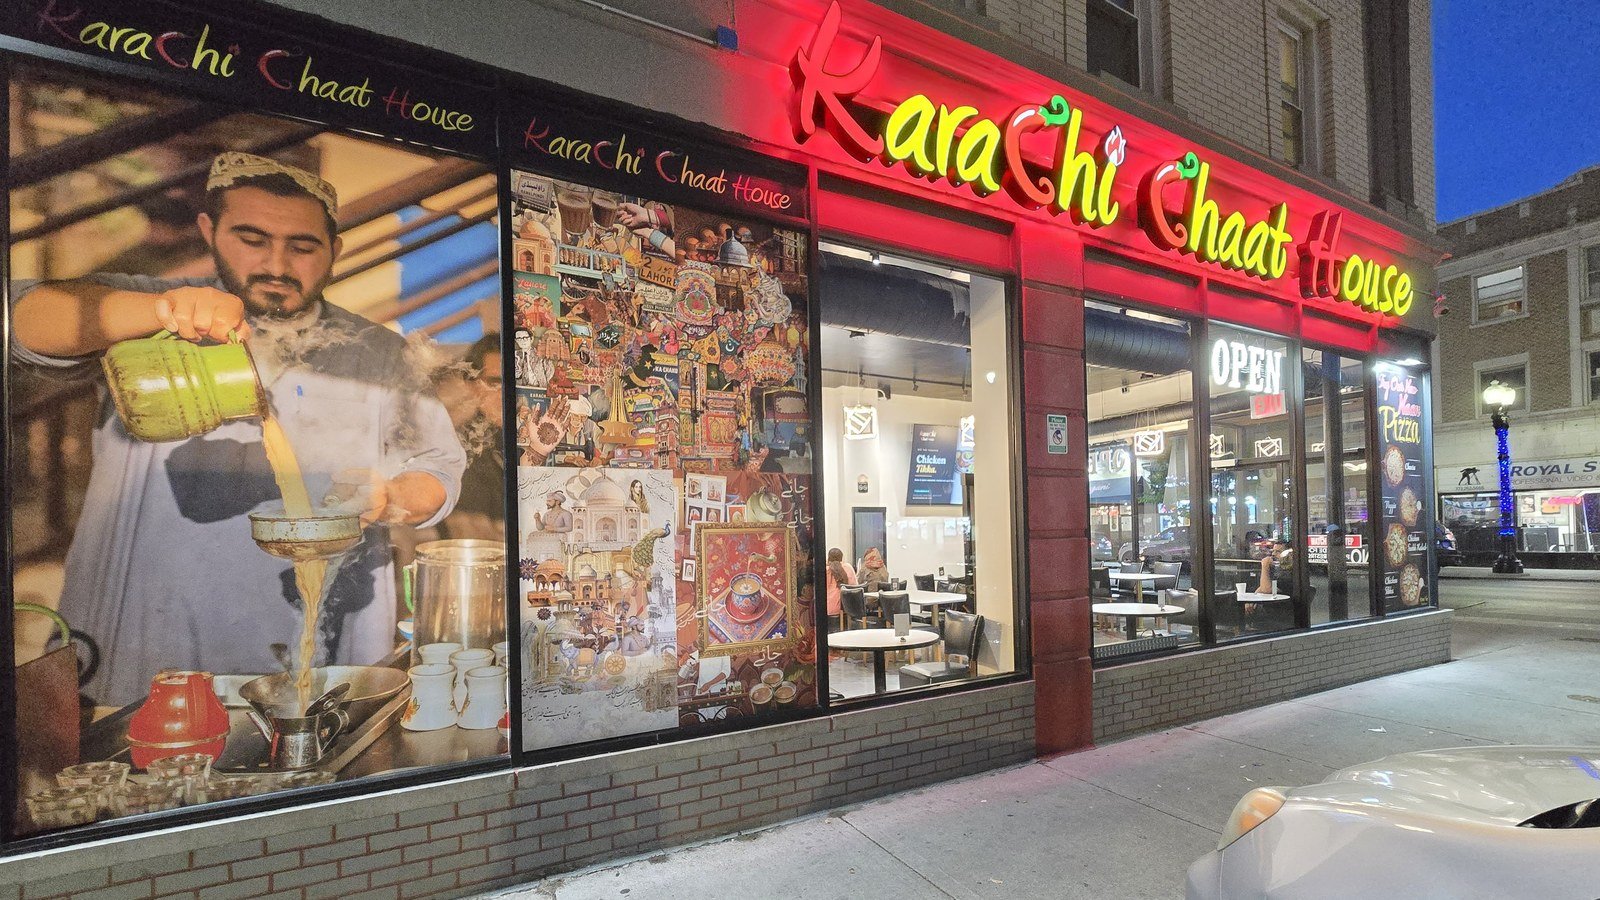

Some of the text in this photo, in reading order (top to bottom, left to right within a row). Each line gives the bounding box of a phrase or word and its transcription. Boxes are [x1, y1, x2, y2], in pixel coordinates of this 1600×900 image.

[257, 49, 373, 108] Chaat
[383, 89, 476, 132] House
[655, 150, 727, 194] Chaat
[732, 174, 792, 210] House
[1140, 152, 1293, 280] Chaat
[1296, 209, 1414, 318] House
[1211, 338, 1283, 396] OPEN
[1378, 405, 1421, 444] Pizza
[916, 454, 947, 465] Chicken
[1510, 461, 1600, 477] ROYAL S
[1566, 474, 1594, 482] VIDEO
